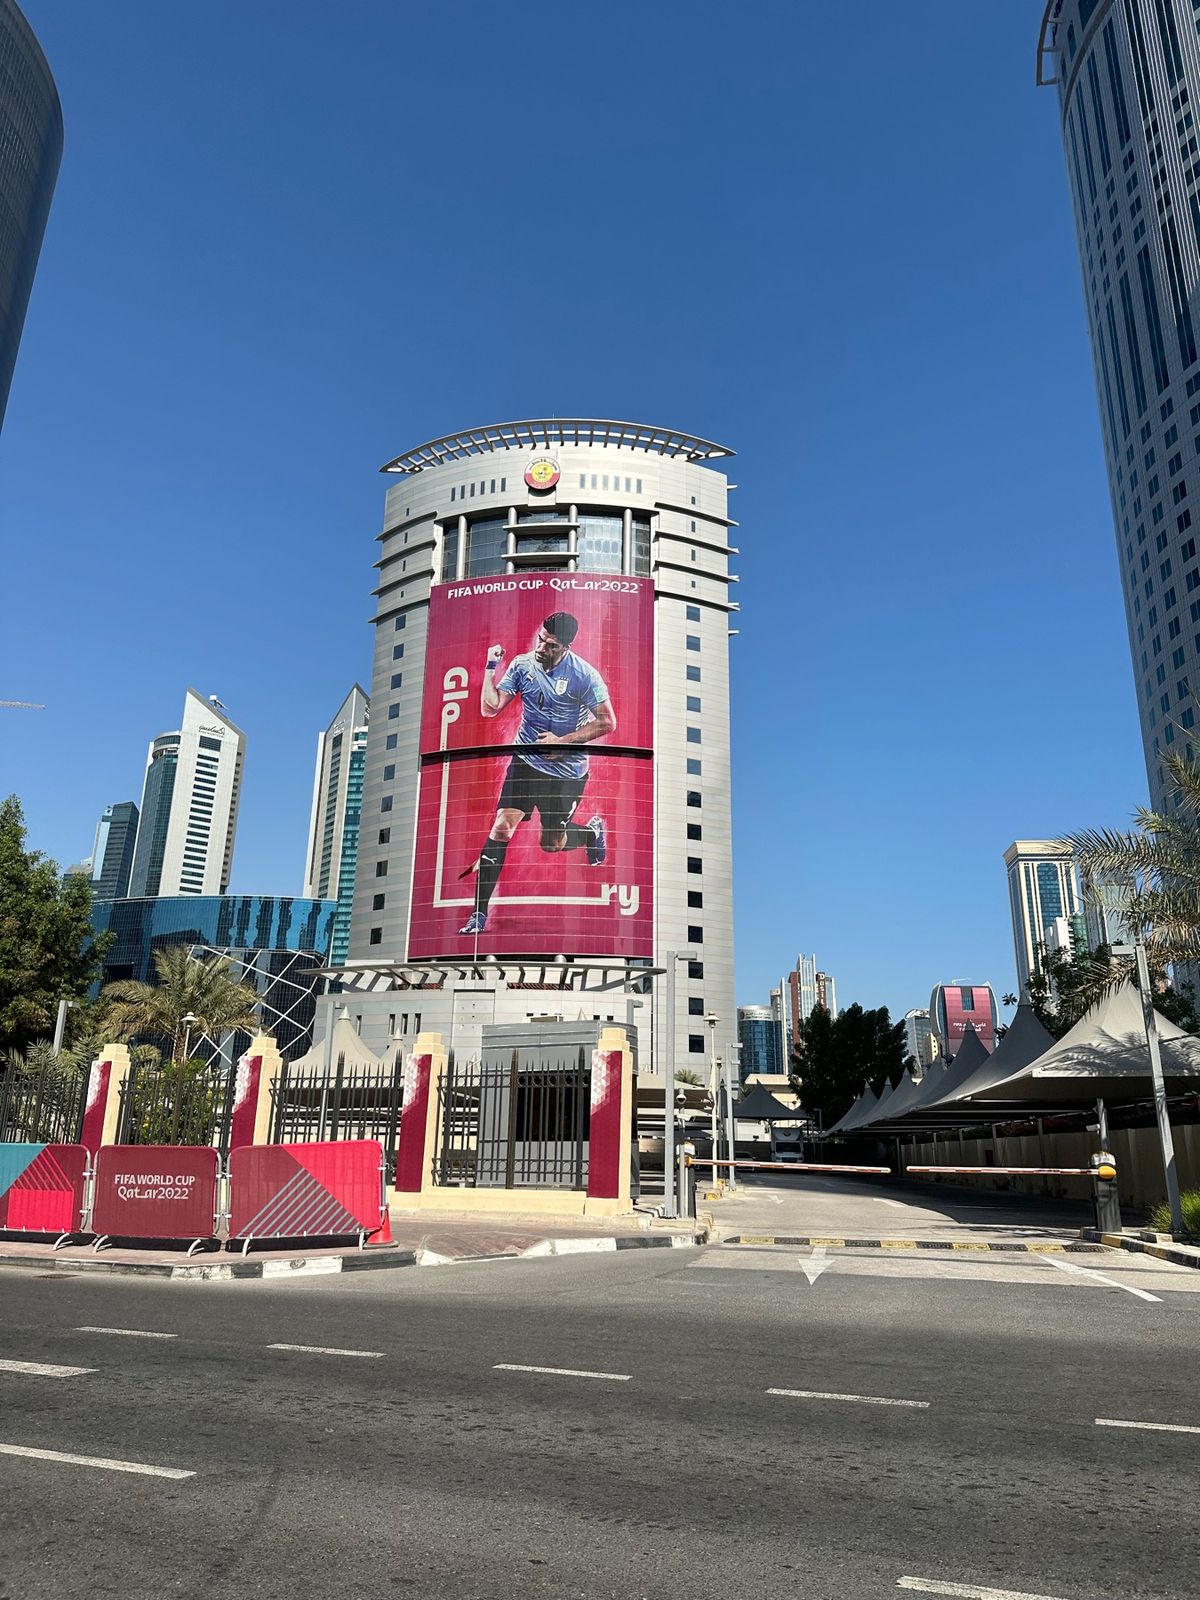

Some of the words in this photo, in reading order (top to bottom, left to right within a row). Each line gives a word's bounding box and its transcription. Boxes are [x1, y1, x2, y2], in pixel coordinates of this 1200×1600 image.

[447, 586, 472, 599] FIFA
[473, 581, 517, 595] WORLD
[518, 579, 544, 590] CUP
[114, 1174, 136, 1185] FIFA
[137, 1174, 174, 1185] WORLD
[175, 1175, 196, 1186] CUP
